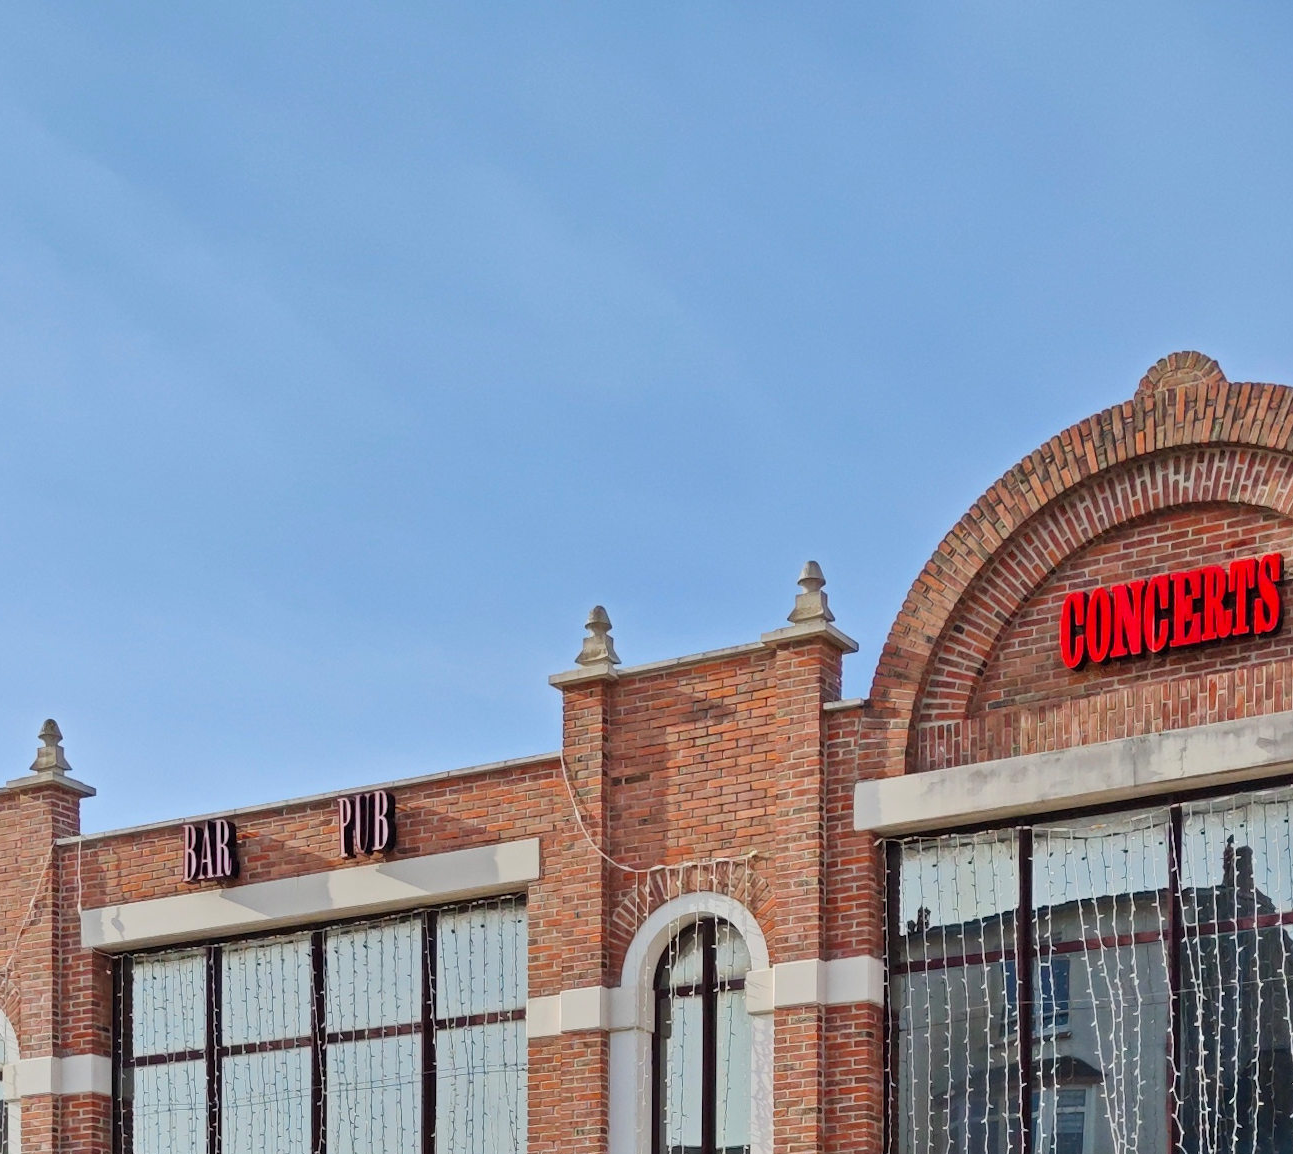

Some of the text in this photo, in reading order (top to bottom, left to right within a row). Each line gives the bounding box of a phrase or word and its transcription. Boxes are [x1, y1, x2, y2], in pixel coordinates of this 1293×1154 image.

[1060, 552, 1283, 669] CONCERTS
[182, 789, 392, 882] BAR PUB
